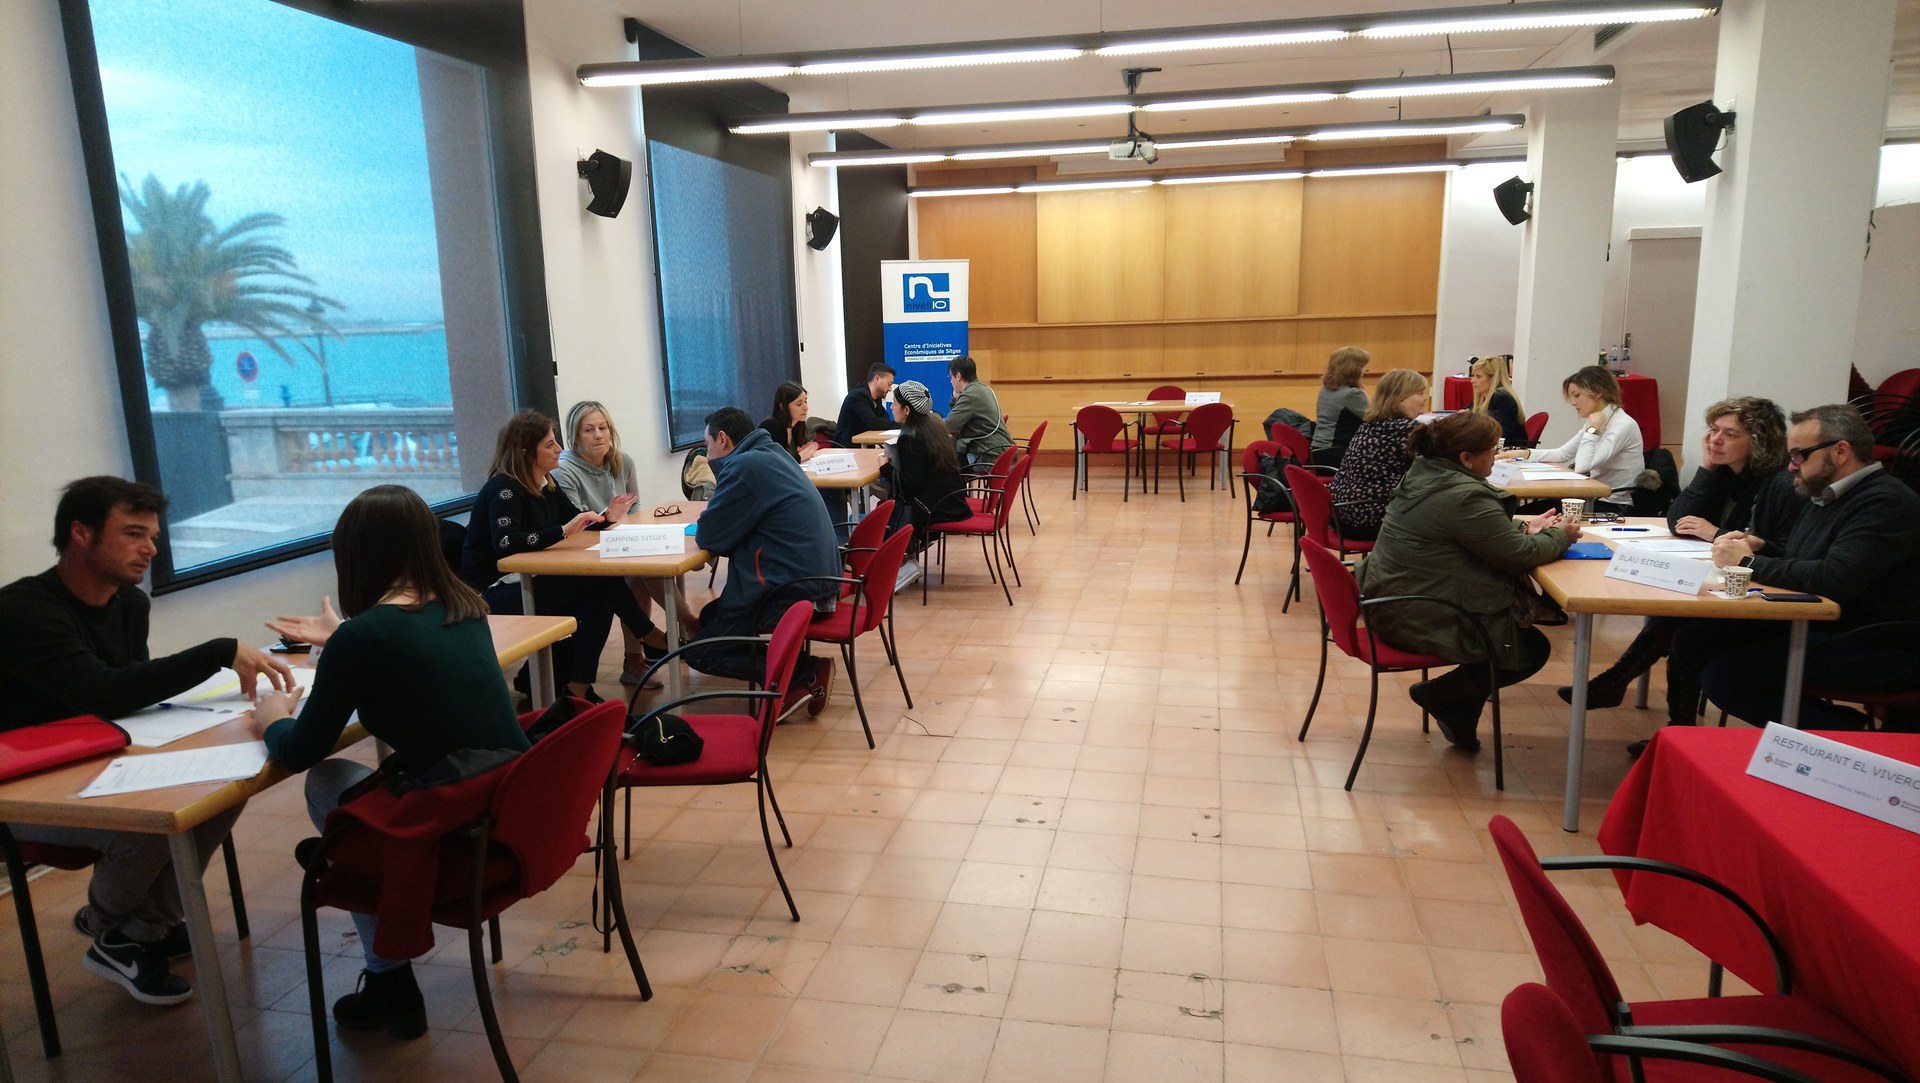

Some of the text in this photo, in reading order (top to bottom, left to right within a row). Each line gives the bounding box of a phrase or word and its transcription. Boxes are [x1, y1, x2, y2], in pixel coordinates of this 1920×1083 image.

[1618, 554, 1671, 570] BLAU SITGES
[1772, 735, 1852, 767] RESTAURANT
[1853, 760, 1868, 773] EL
